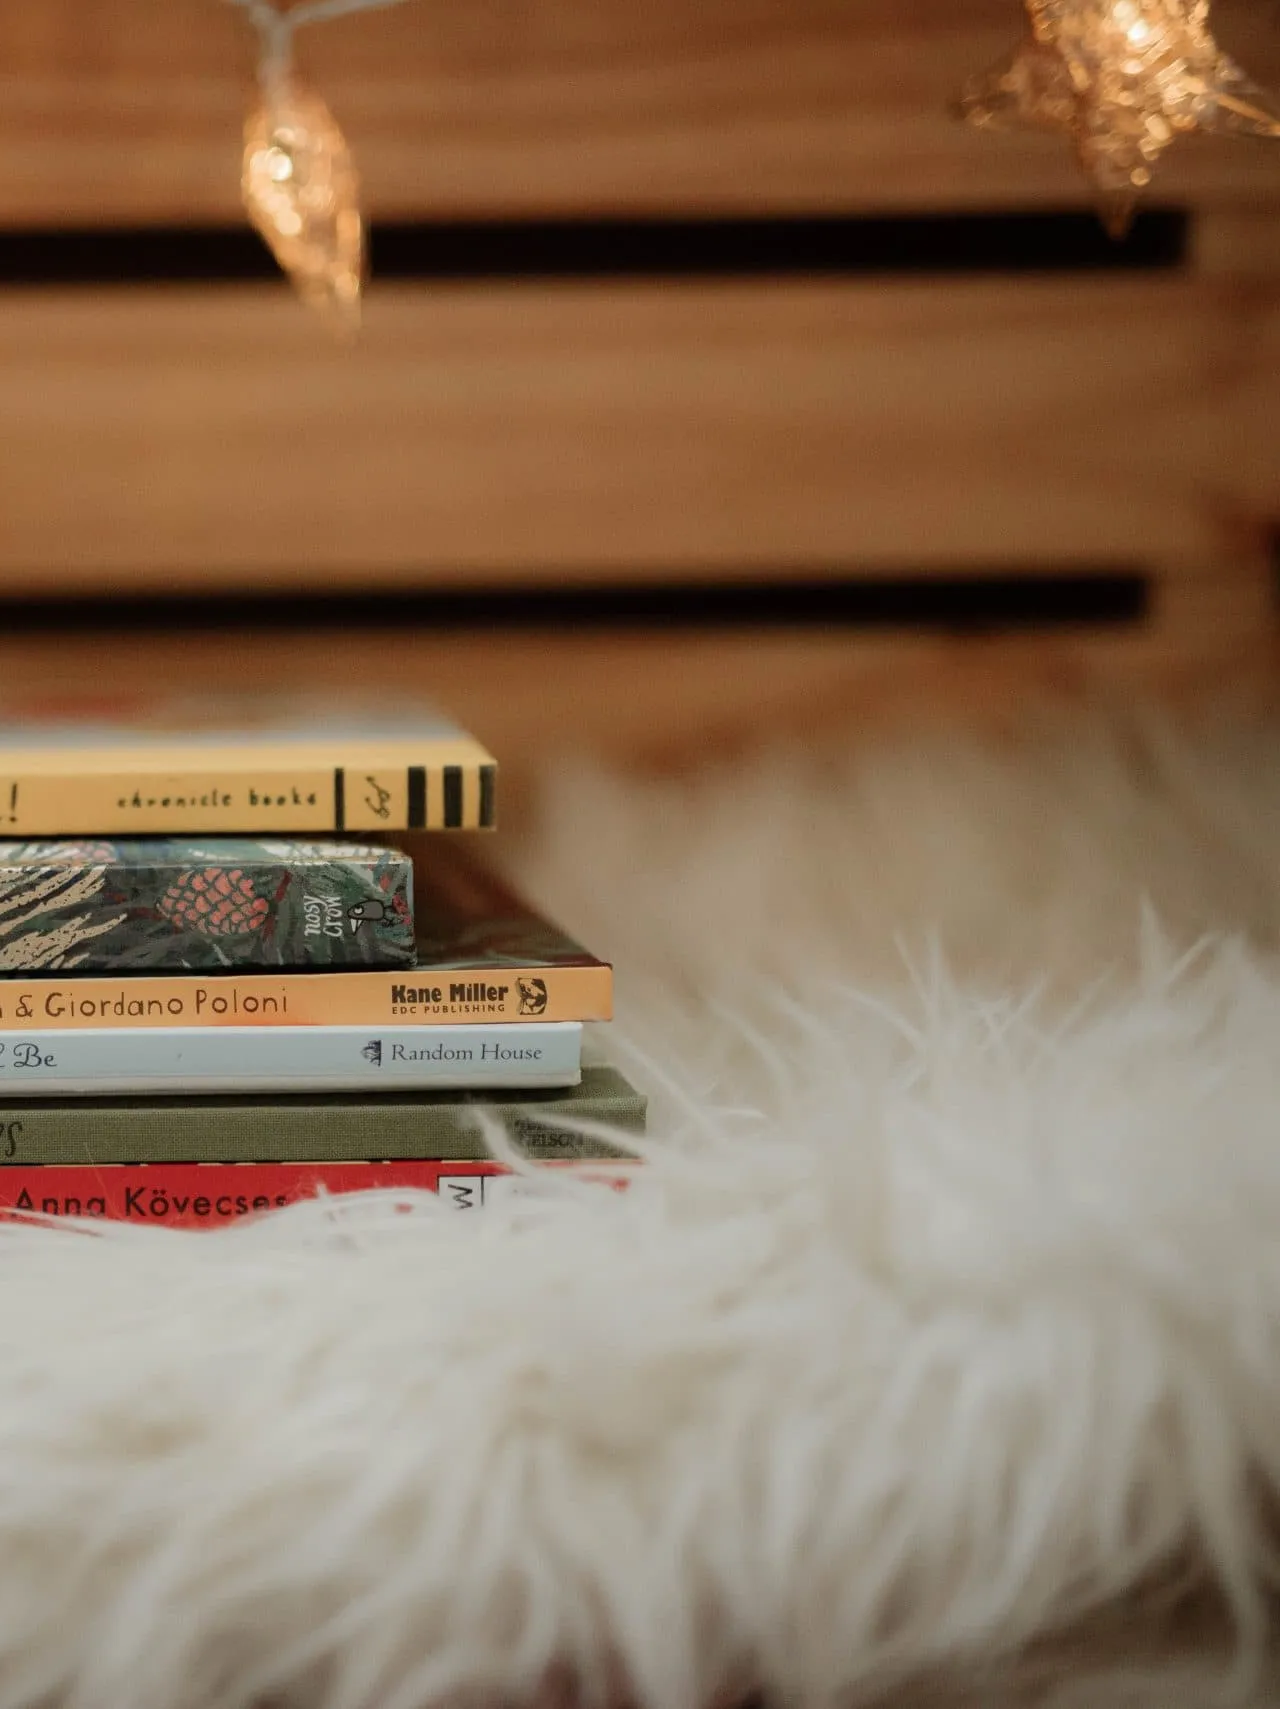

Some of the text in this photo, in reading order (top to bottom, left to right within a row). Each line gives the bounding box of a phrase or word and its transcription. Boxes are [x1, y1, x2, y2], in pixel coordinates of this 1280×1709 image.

[117, 787, 316, 808] chronicle books
[304, 895, 329, 937] nosy
[323, 896, 343, 937] crow
[16, 994, 33, 1018] &
[44, 991, 184, 1017] Giordano
[195, 988, 288, 1015] Poloni
[391, 983, 509, 1004] Kane Miller
[392, 1003, 505, 1015] EDC PUBLISHING
[13, 1043, 58, 1069] Be
[392, 1043, 543, 1061] Random House
[15, 1187, 106, 1217] Anna
